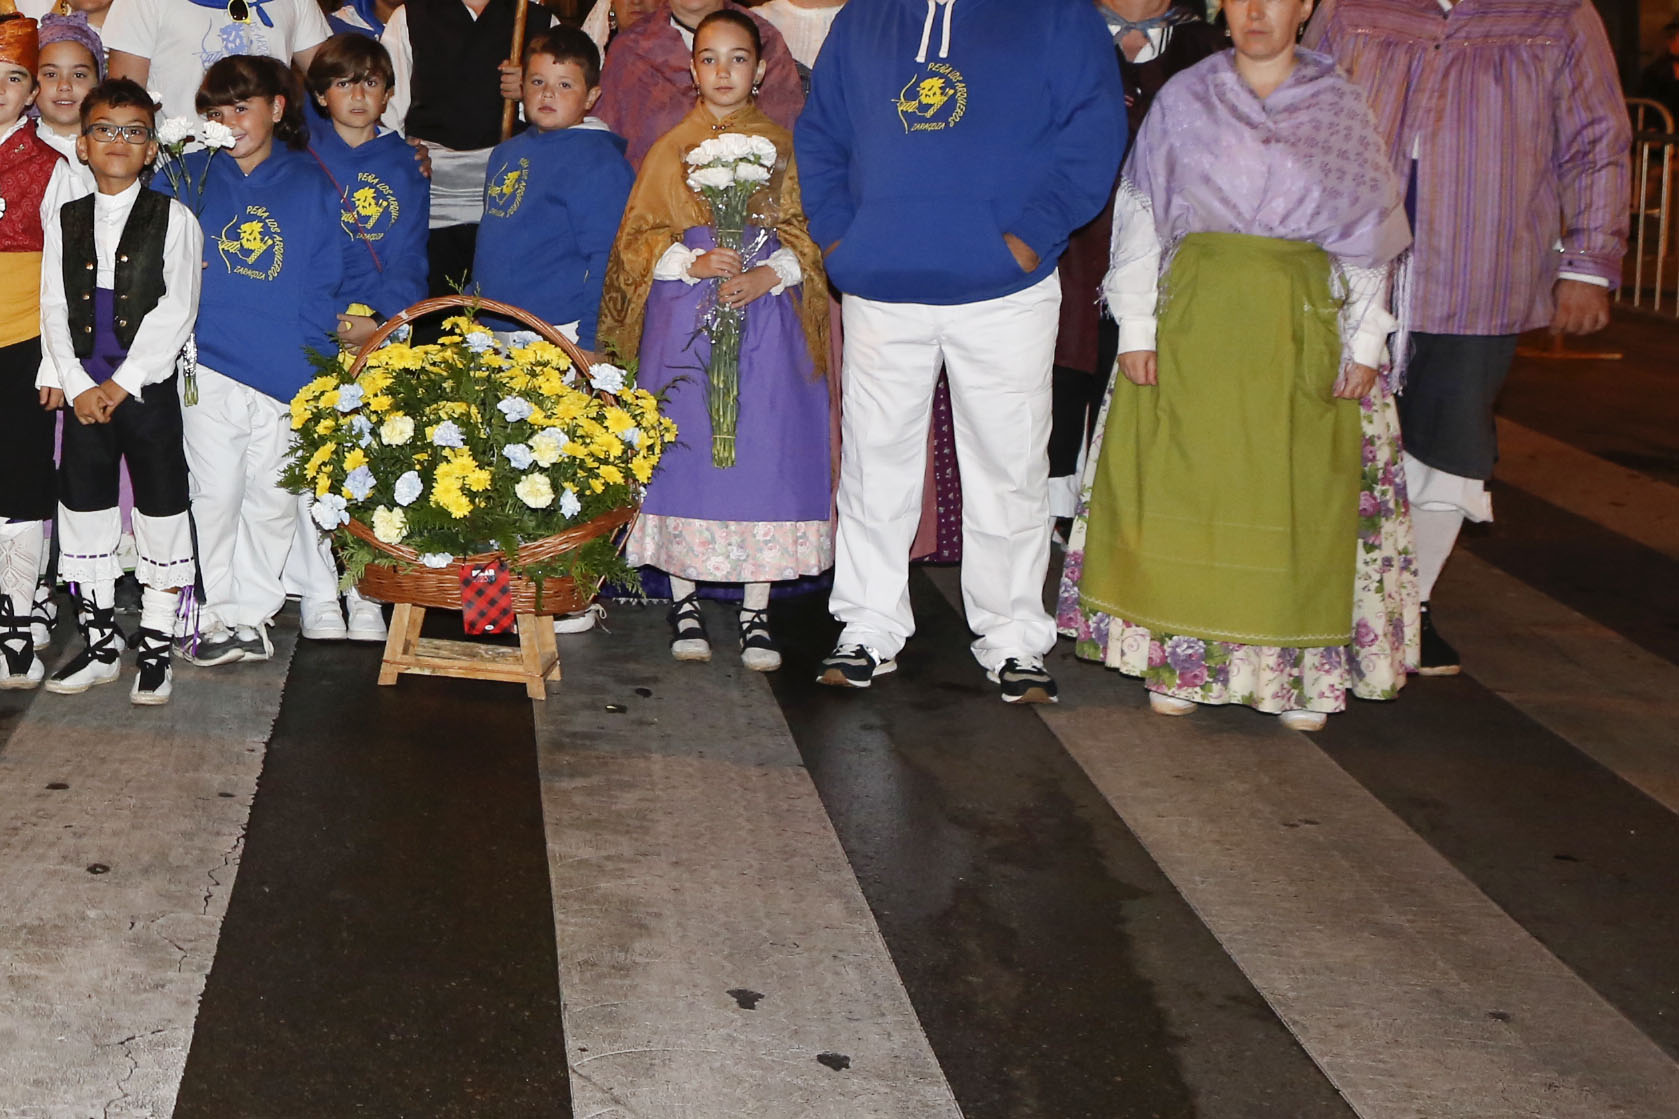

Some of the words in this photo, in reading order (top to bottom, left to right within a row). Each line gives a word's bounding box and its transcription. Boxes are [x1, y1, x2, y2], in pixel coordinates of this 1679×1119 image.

[948, 70, 963, 82] LOS
[948, 82, 967, 127] ARQUEROS
[911, 122, 946, 131] ZARAGOZA
[265, 218, 281, 233] LOS
[267, 234, 284, 281] ARQUEROS
[233, 265, 266, 280] ZARAGOZA
